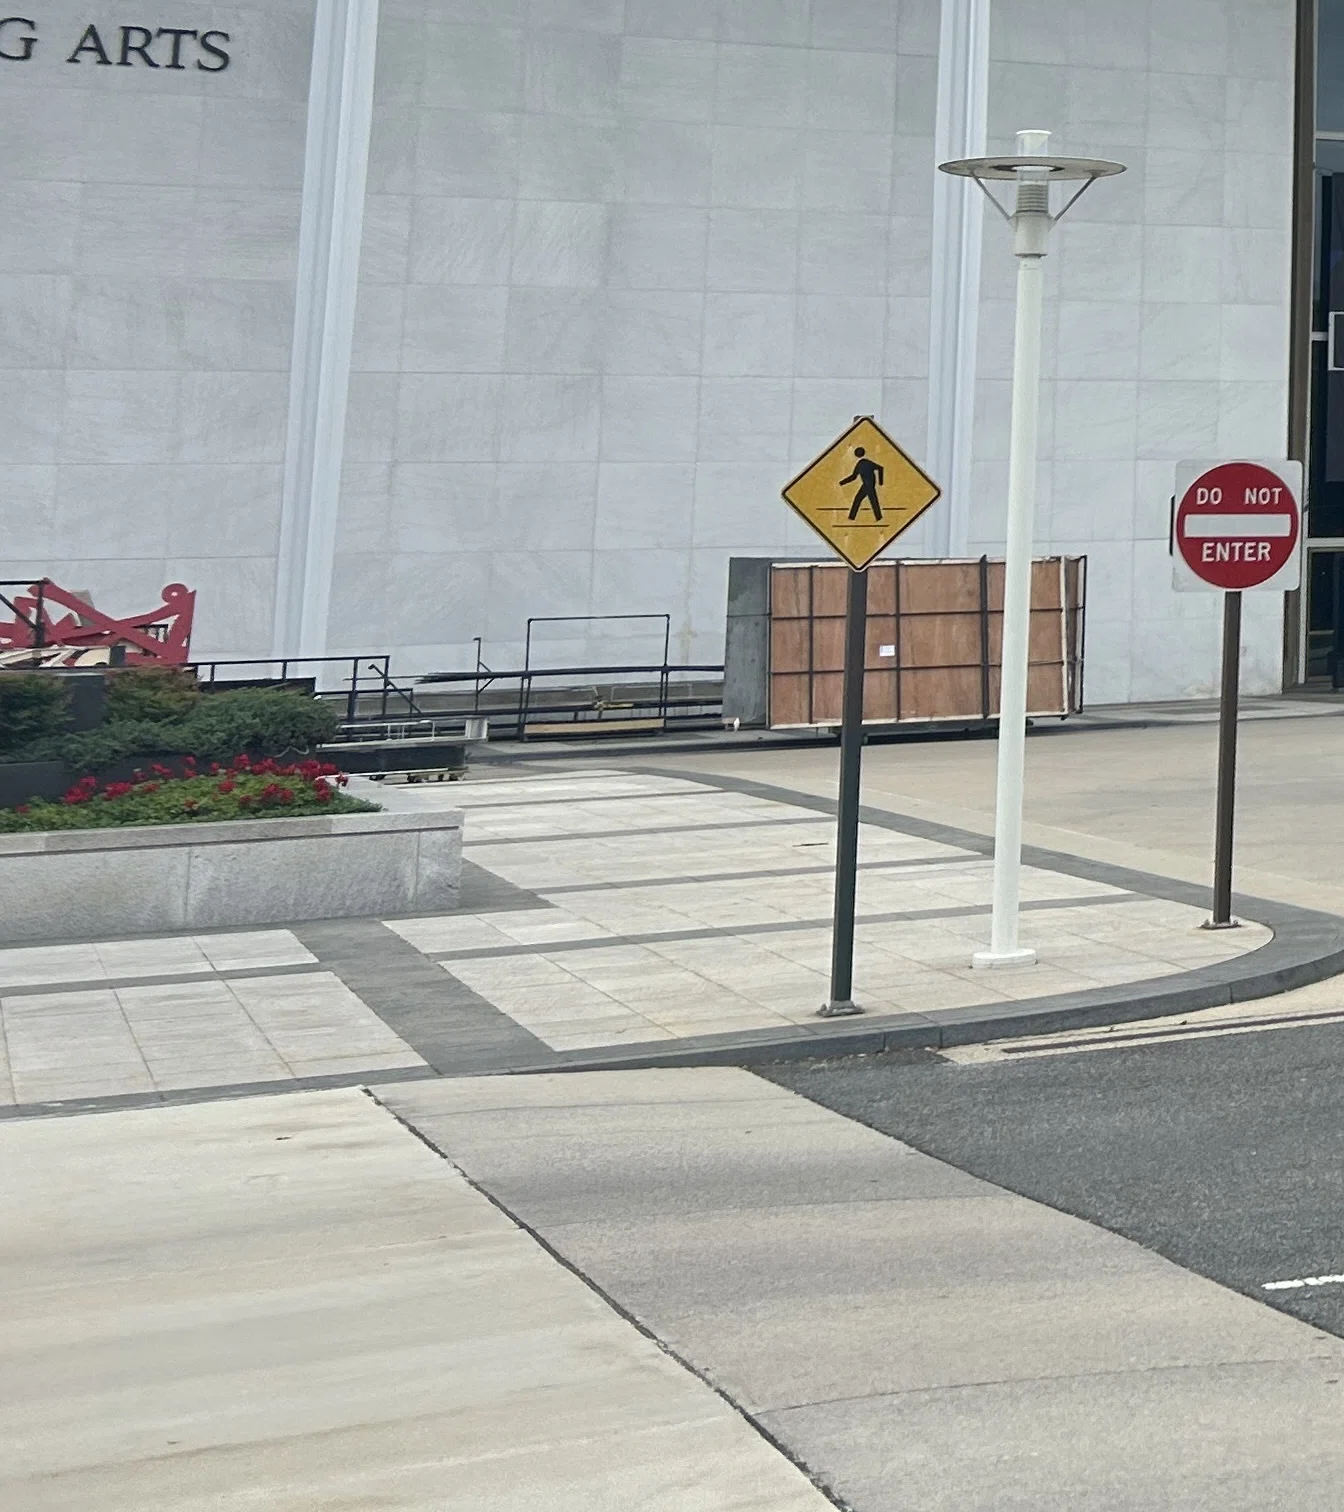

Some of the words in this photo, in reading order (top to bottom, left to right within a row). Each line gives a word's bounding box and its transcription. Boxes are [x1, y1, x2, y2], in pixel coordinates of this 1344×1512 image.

[66, 23, 231, 72] ARTS
[1196, 487, 1222, 505] DO
[1244, 487, 1282, 505] NOT
[1201, 541, 1271, 562] ENTER
